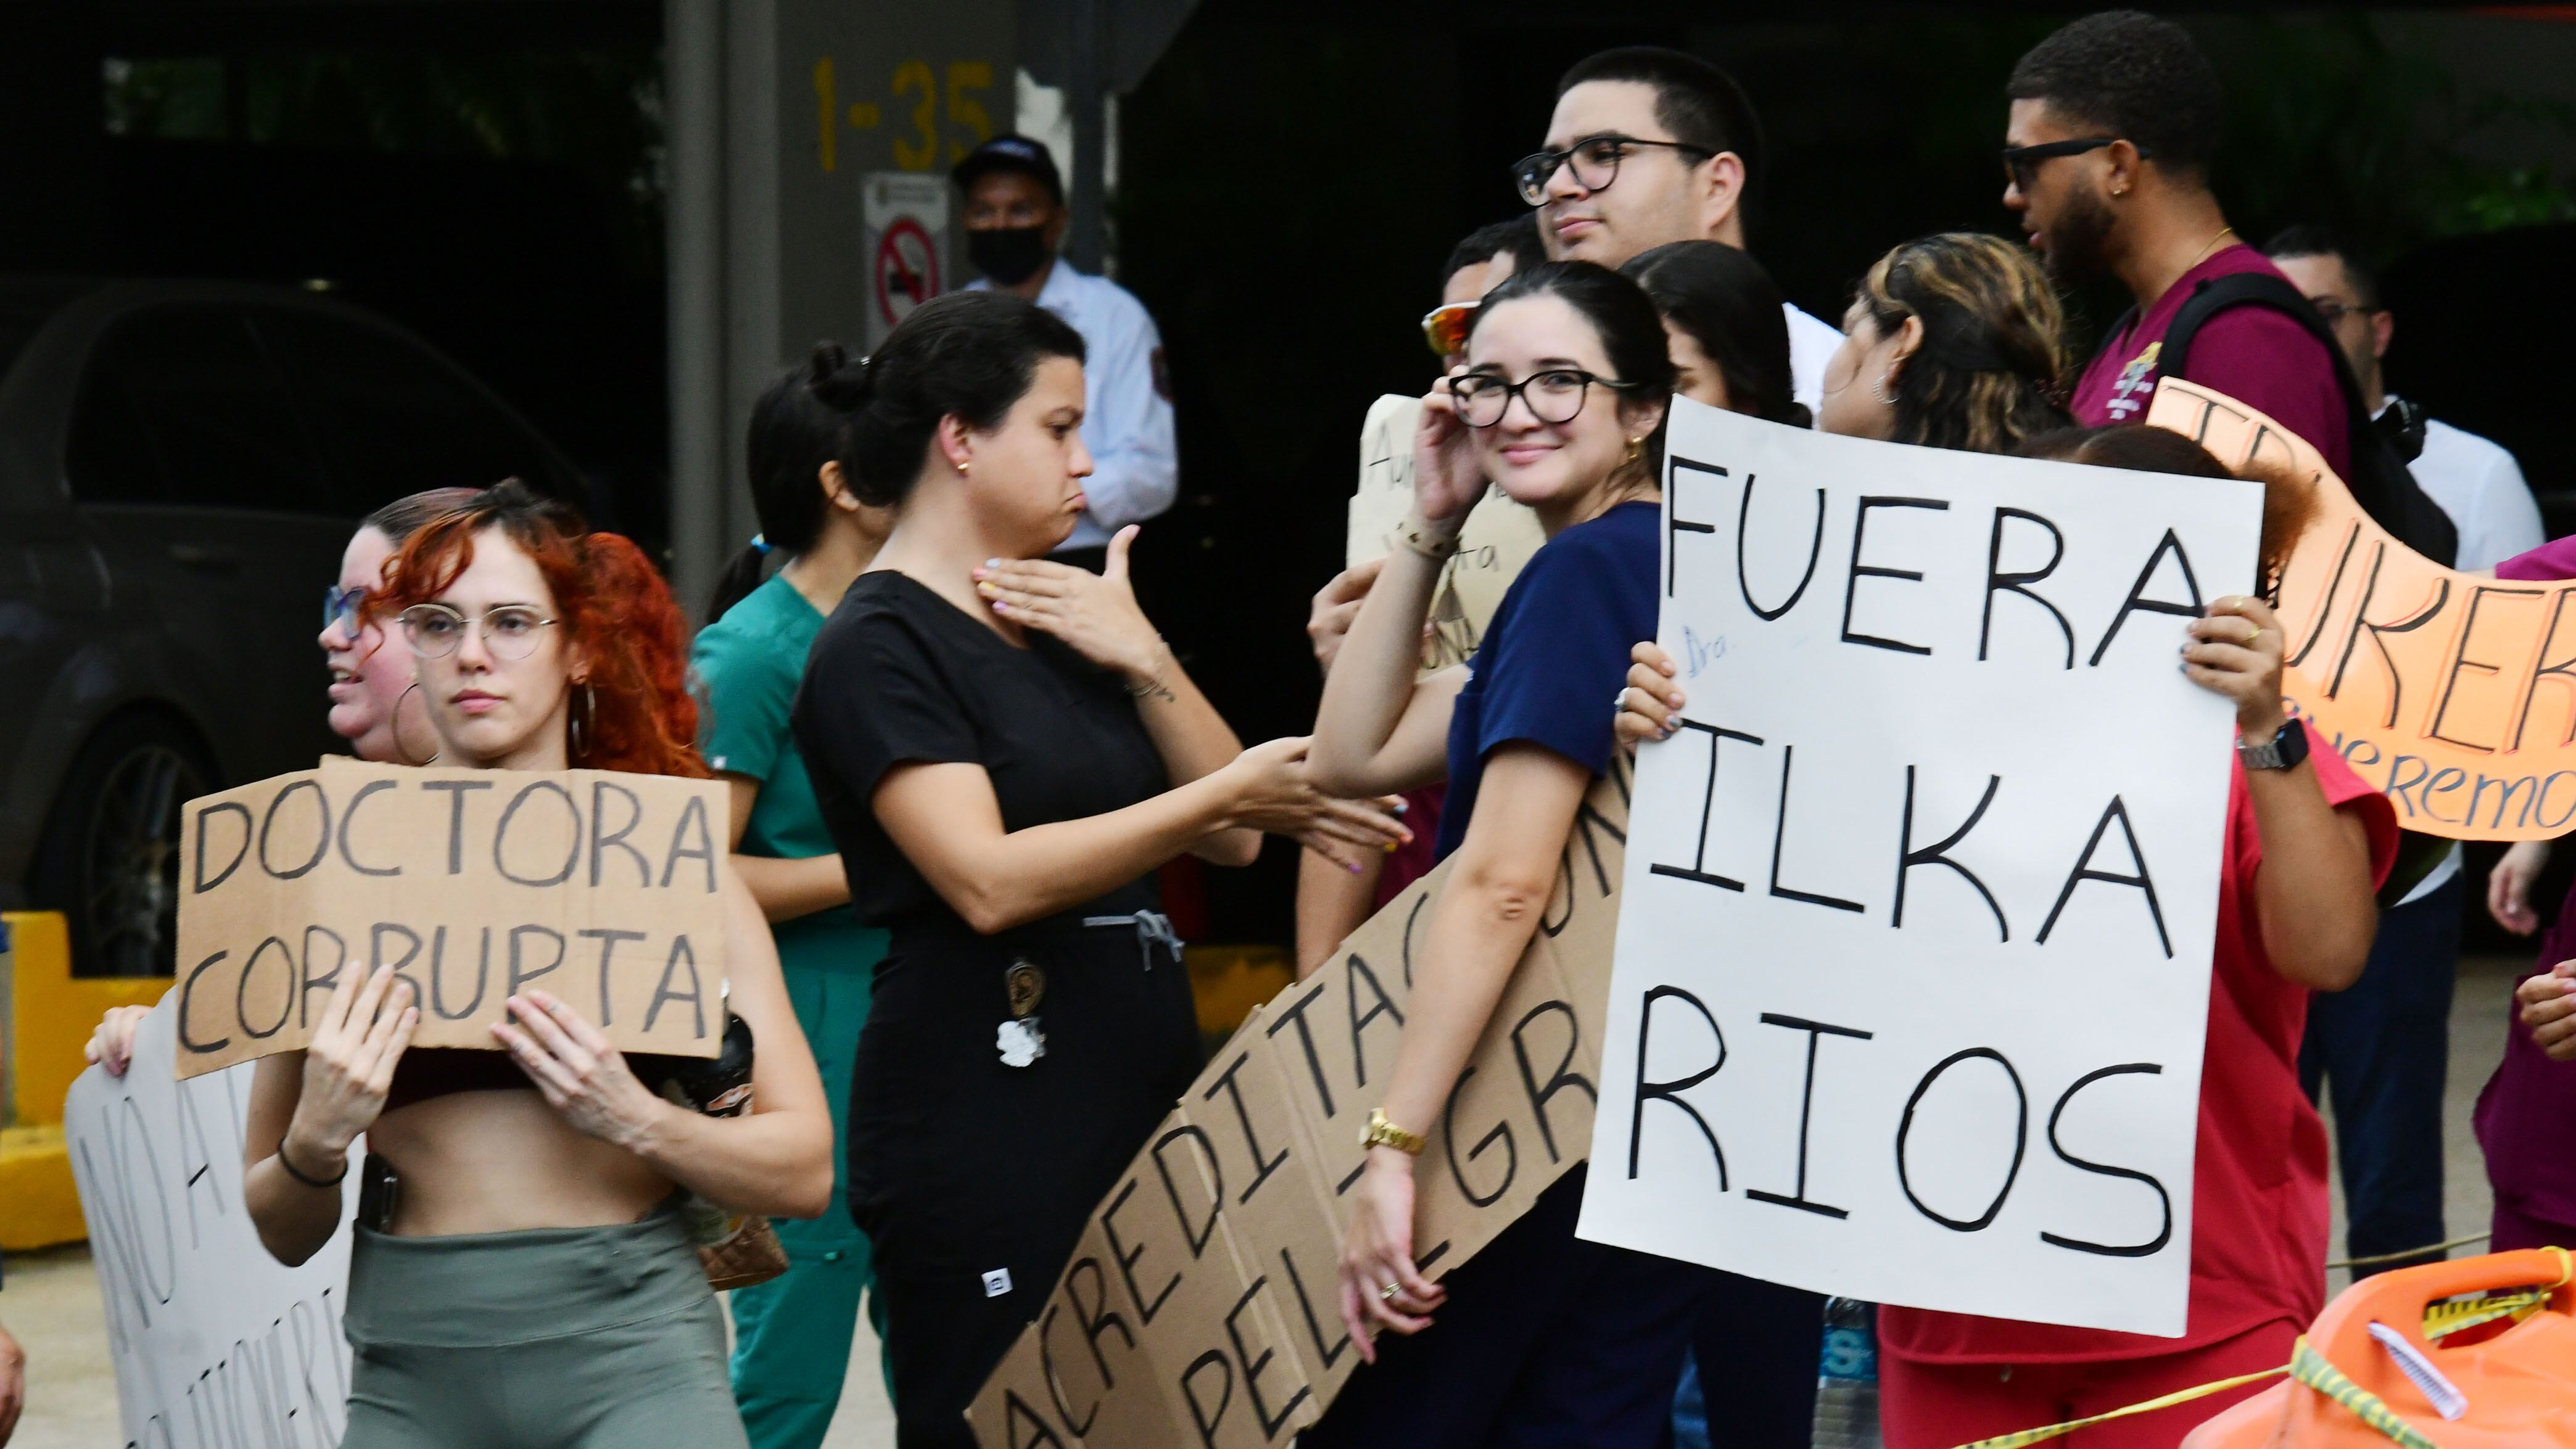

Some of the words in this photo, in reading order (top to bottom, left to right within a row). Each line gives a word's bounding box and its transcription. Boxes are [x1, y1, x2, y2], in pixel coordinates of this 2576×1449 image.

[1667, 455, 2207, 670] FUERA
[194, 779, 718, 894] DOCTORA
[1651, 717, 2173, 959] ILKA
[178, 922, 706, 1054] CORRUPTA
[1629, 984, 2172, 1257] RIOS
